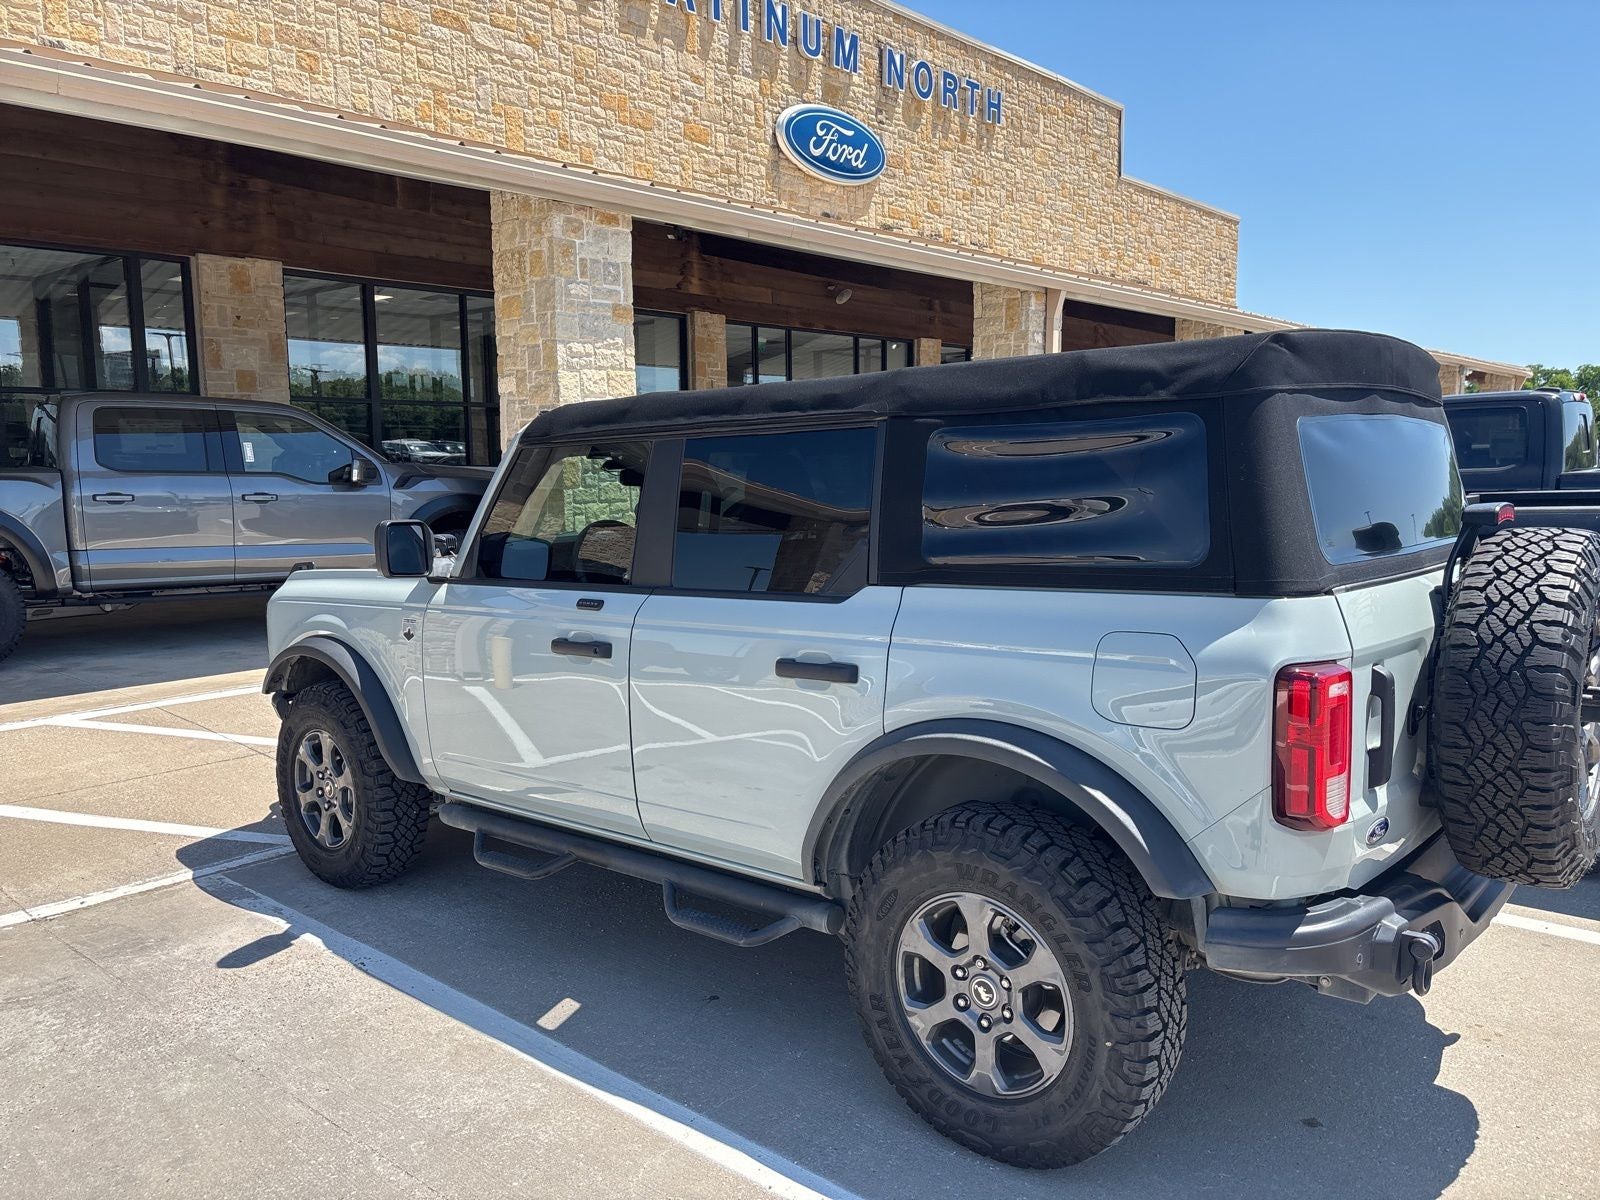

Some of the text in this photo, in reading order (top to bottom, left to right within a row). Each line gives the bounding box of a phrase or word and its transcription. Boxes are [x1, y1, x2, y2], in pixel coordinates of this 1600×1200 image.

[665, 0, 1004, 125] INUM NORTH
[809, 118, 869, 170] Ford
[953, 861, 1093, 993] WRANGLER
